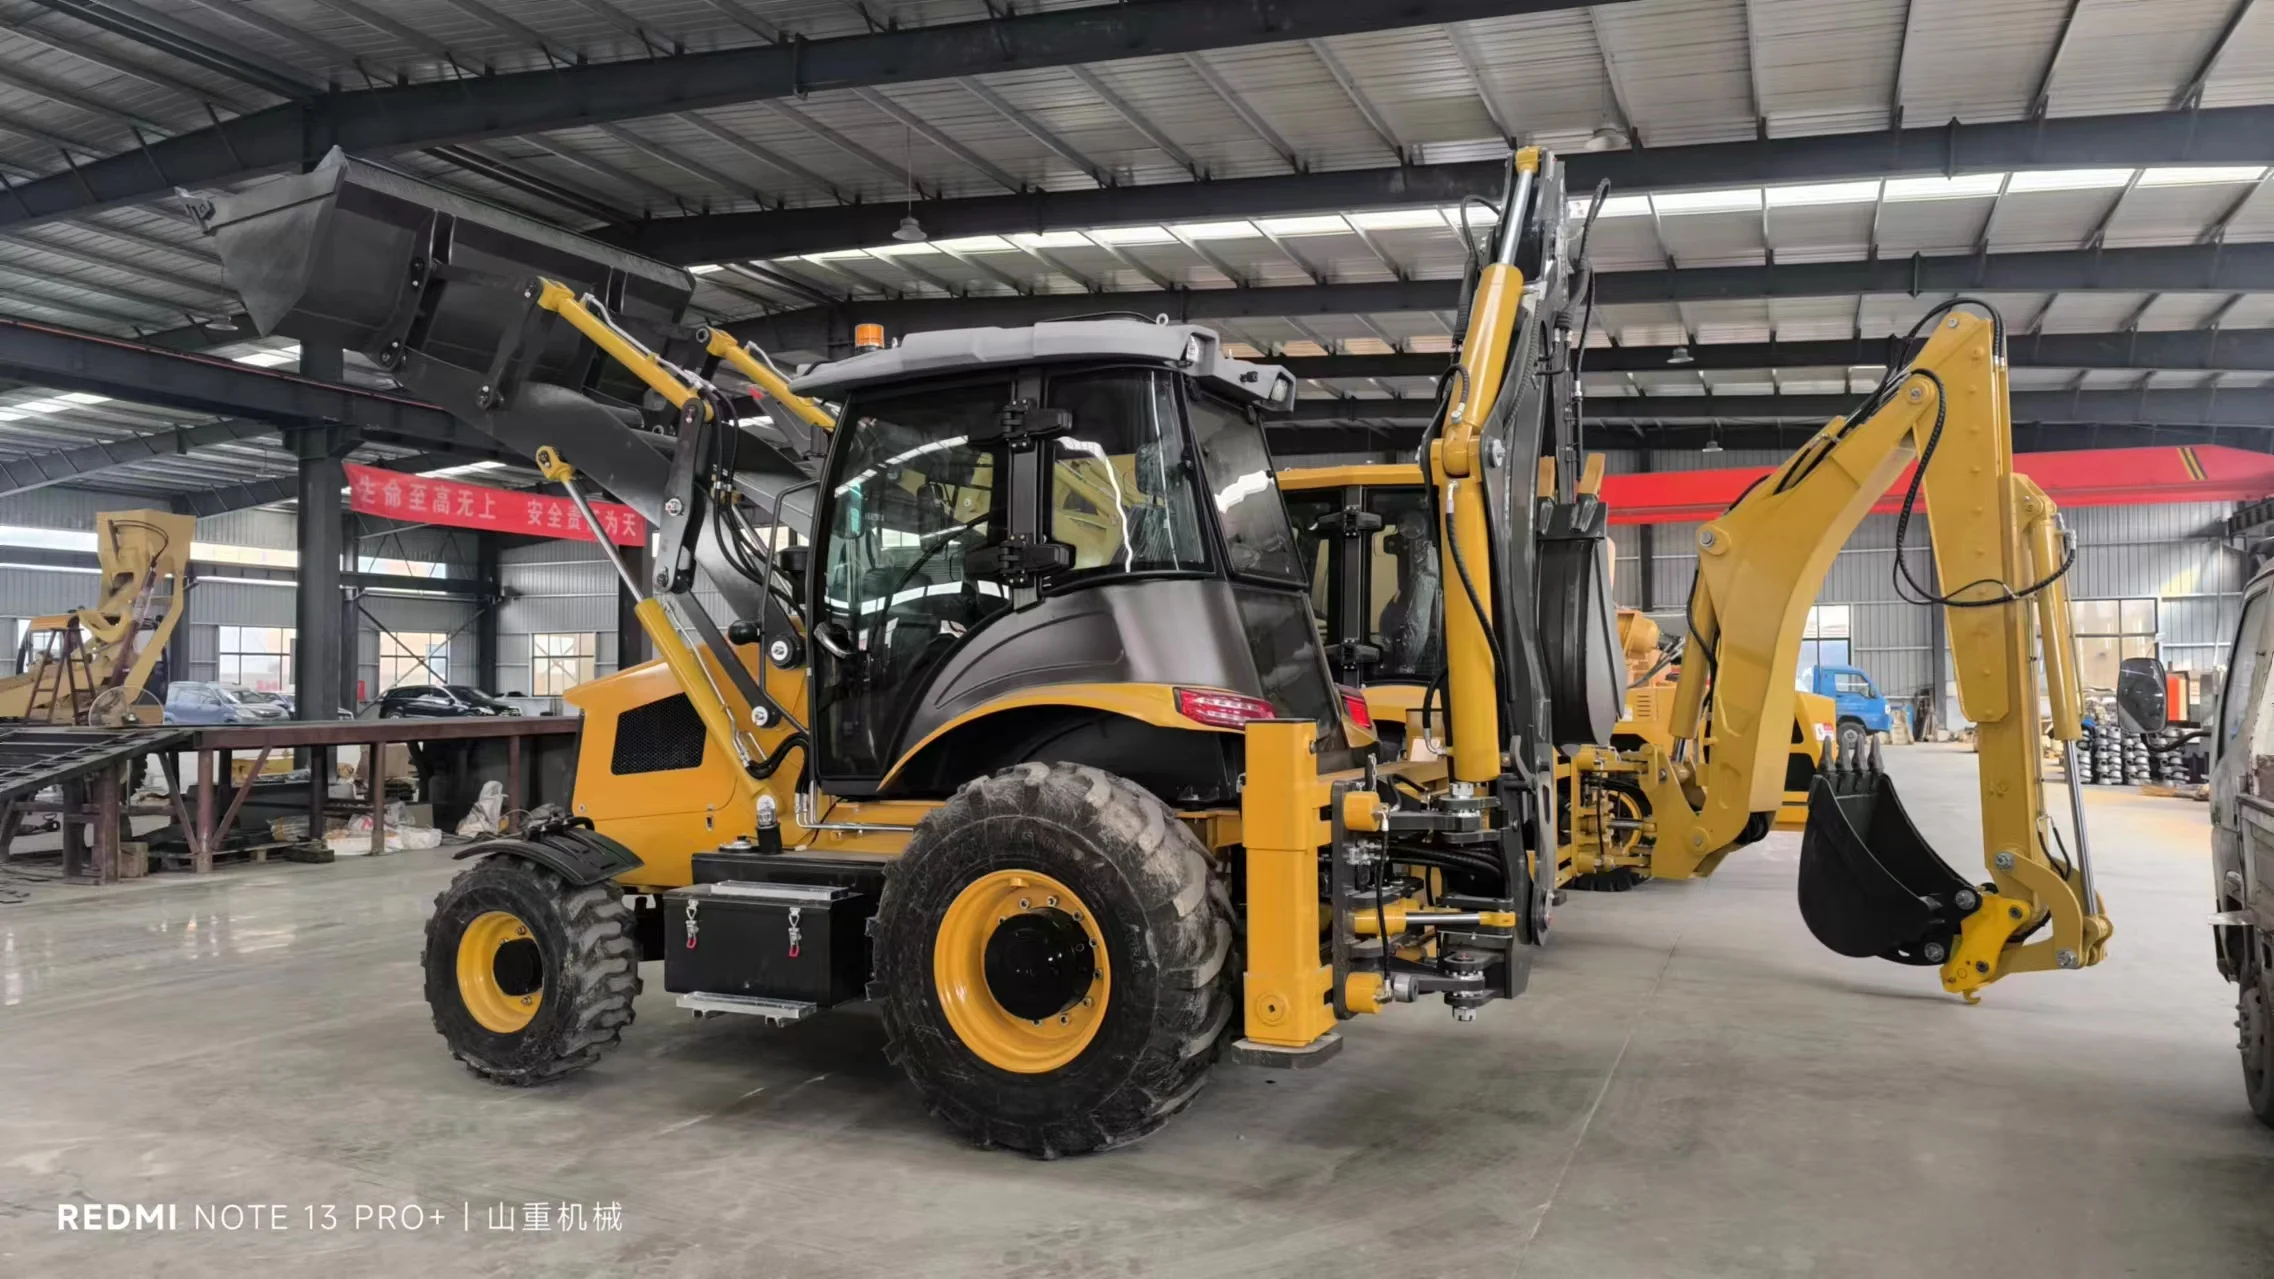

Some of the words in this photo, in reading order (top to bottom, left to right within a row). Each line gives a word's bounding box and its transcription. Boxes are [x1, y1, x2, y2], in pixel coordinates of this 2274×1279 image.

[358, 474, 496, 520] 生命至高无上
[527, 498, 637, 537] 安全责为天
